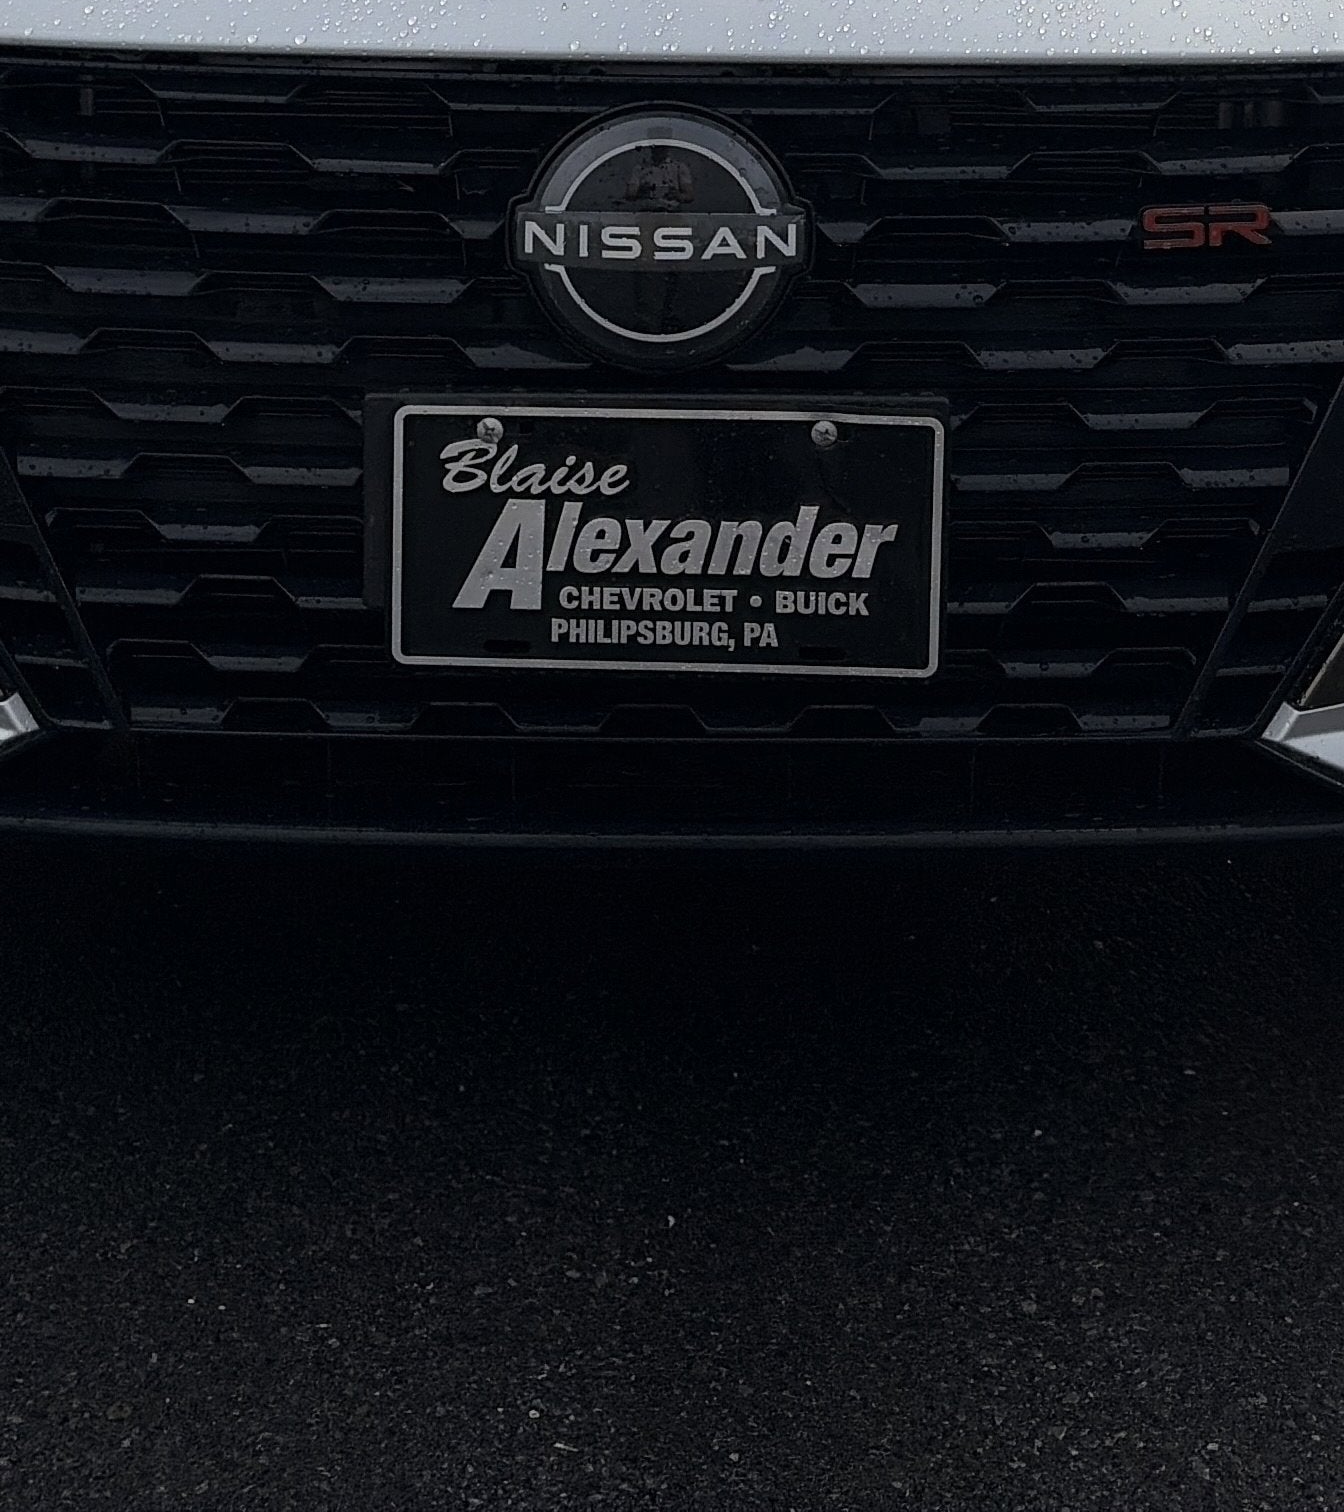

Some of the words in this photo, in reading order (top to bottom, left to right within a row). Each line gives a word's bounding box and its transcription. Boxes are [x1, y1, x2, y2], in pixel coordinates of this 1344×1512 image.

[524, 220, 797, 260] NISSAN
[1142, 204, 1272, 250] SR
[440, 438, 631, 496] Blaise
[452, 498, 899, 611] Alexander
[559, 585, 738, 613] CHEVROLET
[775, 590, 870, 616] BUICK
[551, 618, 736, 651] PHILIPSBURG,
[744, 622, 779, 648] PA
